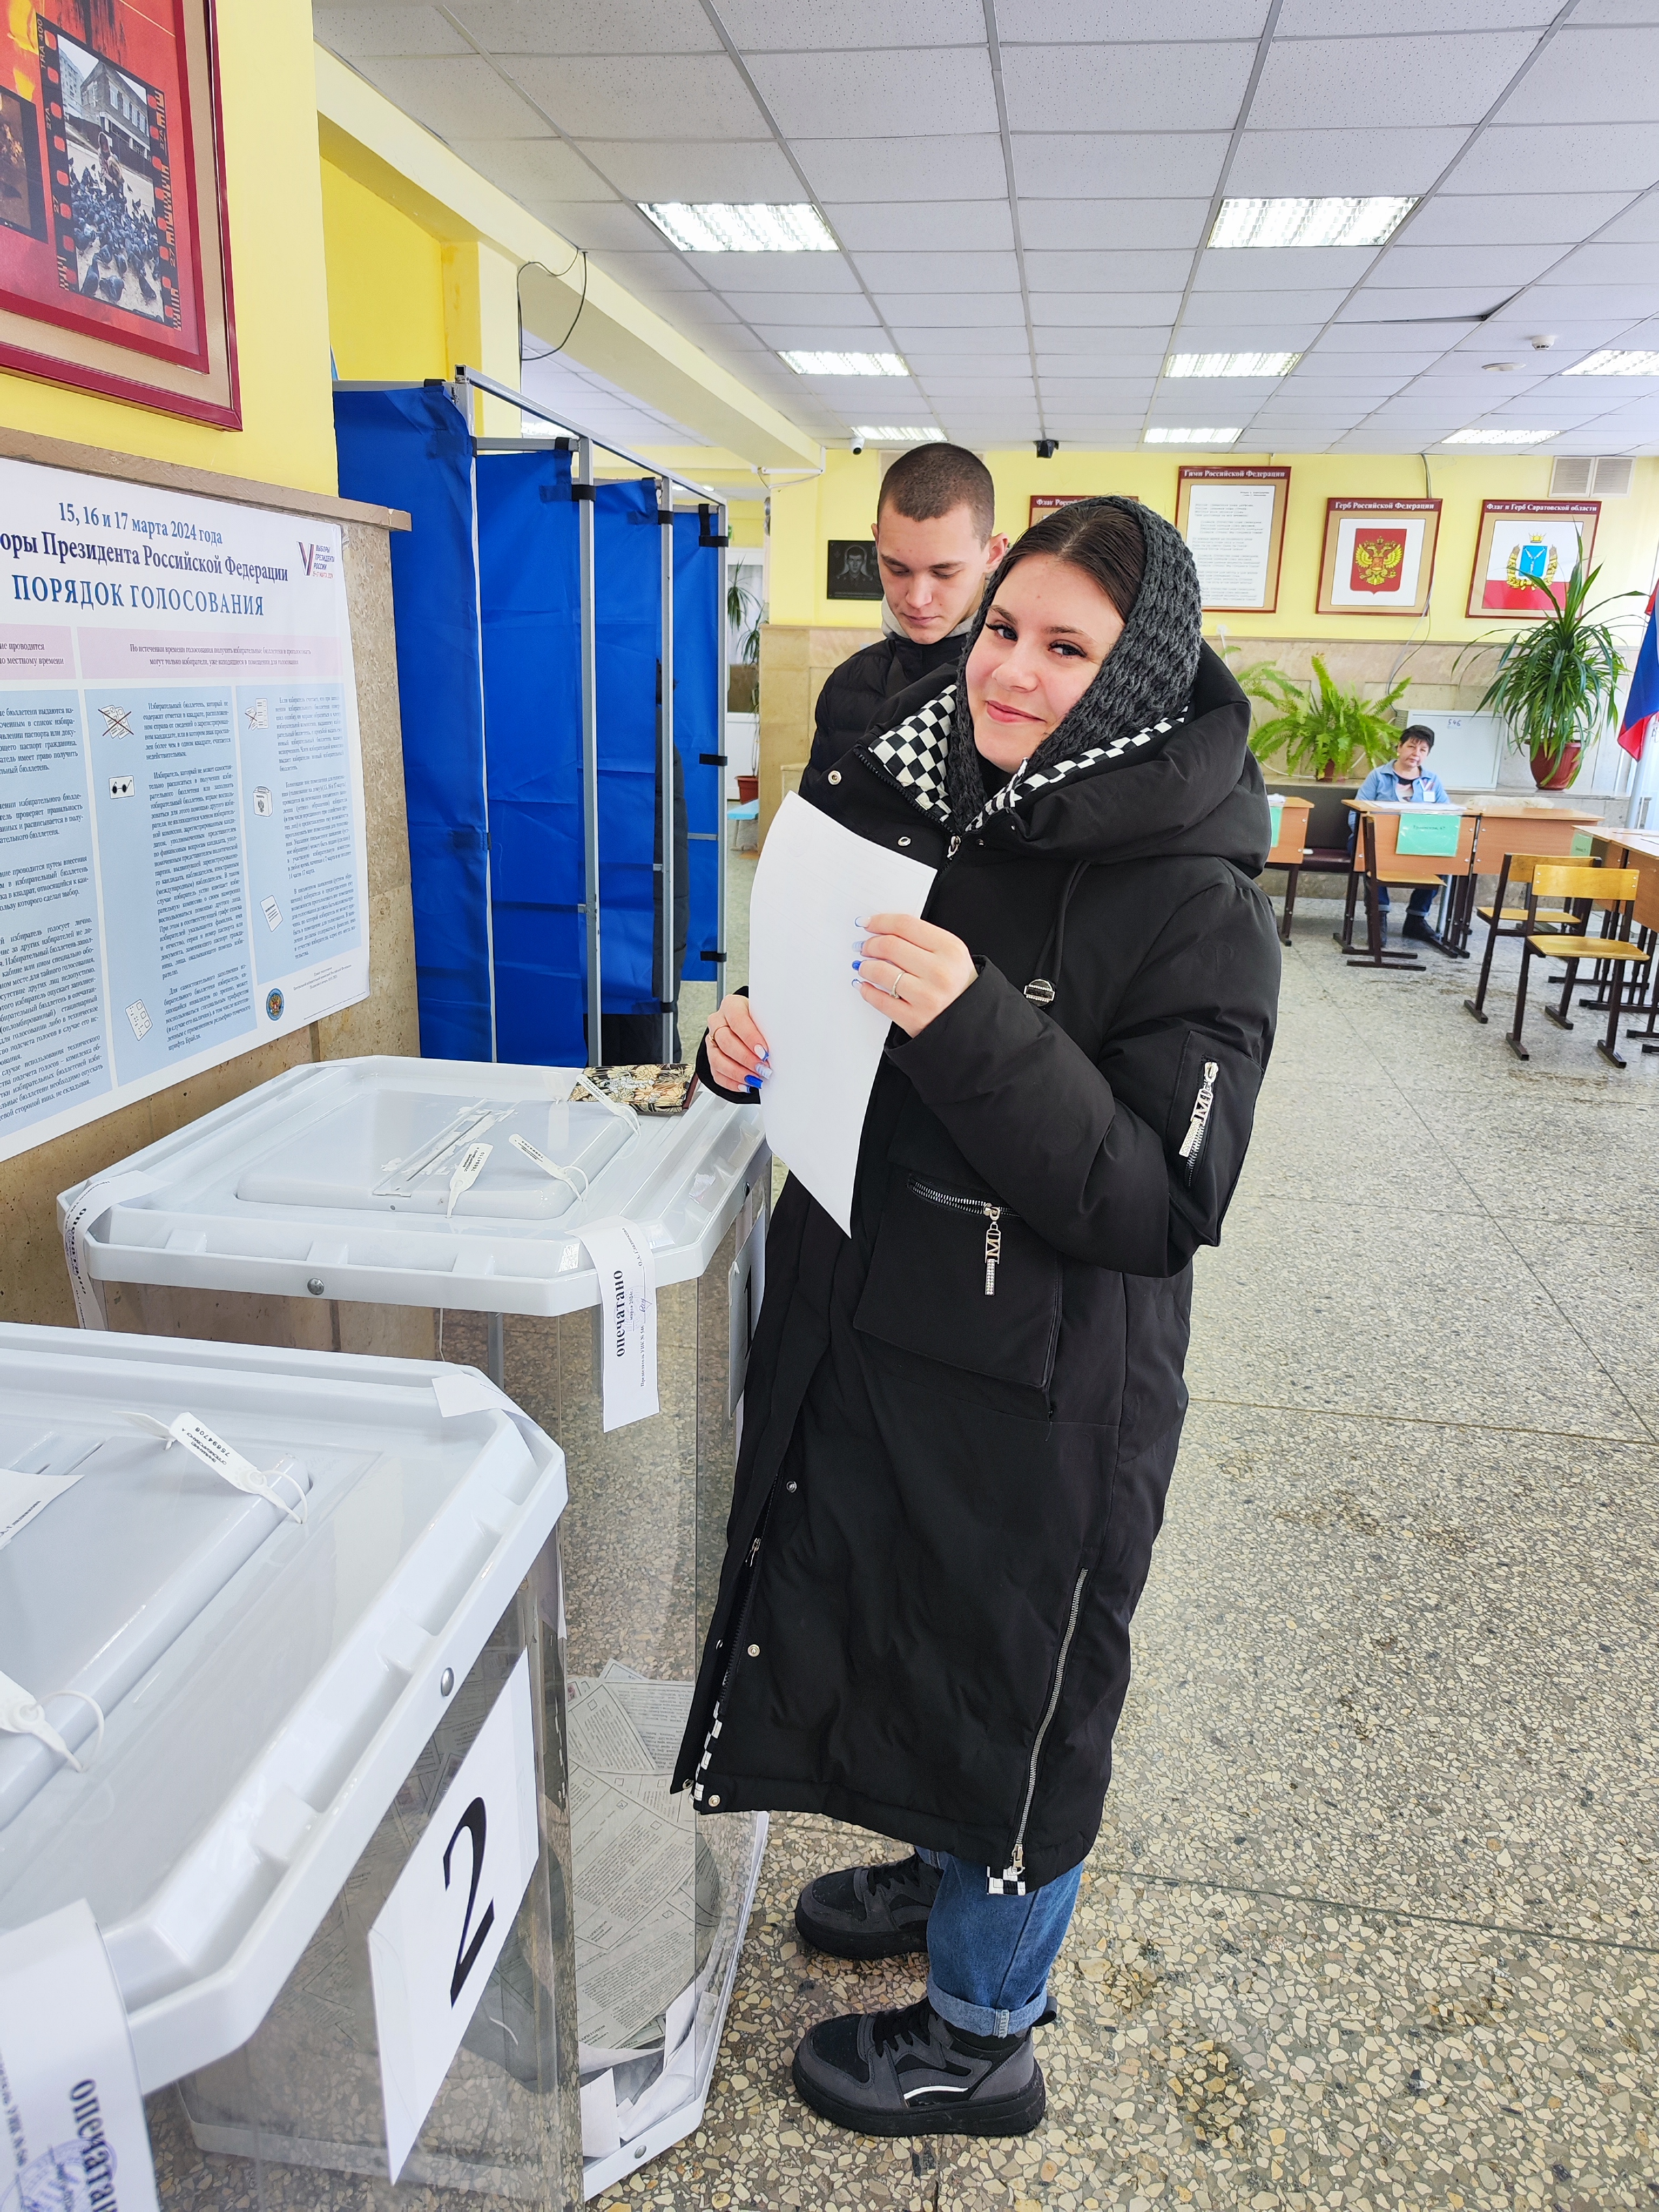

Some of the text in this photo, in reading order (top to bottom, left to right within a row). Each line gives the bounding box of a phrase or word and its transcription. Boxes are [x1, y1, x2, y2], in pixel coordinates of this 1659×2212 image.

[52, 195, 59, 214] 27
[168, 247, 176, 268] 27
[1205, 469, 1244, 477] Российской
[1246, 470, 1286, 479] Федерации
[1335, 502, 1434, 511] Герб Российской Федерации
[1510, 503, 1526, 512] Герб
[1527, 503, 1569, 512] Саратовской
[1570, 504, 1597, 512] области
[59, 502, 223, 547] 15, 16 и 17 марта 2024 года
[316, 544, 331, 554] ВЫБОРЫ
[0, 531, 288, 584] оры Президента Российской Федерации
[315, 554, 335, 562] ПРЕЗИДЕНТА
[313, 562, 327, 570] РОССИИ
[11, 574, 264, 616] ПОРЯДОК ГОЛОСОВАНИЯ
[9, 643, 45, 652] проводится
[130, 644, 138, 652] По
[165, 646, 185, 655] времени
[7, 658, 64, 667] местному времени
[150, 658, 164, 667] могут
[182, 657, 209, 667] избиратели,
[209, 659, 218, 667] уже
[6, 707, 38, 716] бюллетени
[149, 702, 182, 711] Избирательный
[55, 717, 75, 726] избира-
[24, 731, 50, 739] паспорта
[19, 740, 77, 751] паспорт гражданина.
[36, 753, 52, 761] право
[53, 751, 78, 760] получить
[18, 793, 82, 807] избирательного бюлле-
[16, 809, 44, 820] проверяет
[47, 804, 83, 815] правильность
[24, 817, 64, 831] расписывается
[69, 814, 84, 823] полу-
[29, 828, 60, 839] бюллетеня.
[12, 856, 87, 877] проводится путем внесения
[15, 866, 89, 887] избирательный бюллетень
[13, 887, 37, 898] квадрат,
[37, 879, 72, 893] относящийся
[17, 888, 80, 907] которого сделан выбор.
[10, 917, 92, 942] избиратель голосует лично.
[20, 941, 40, 952] других
[42, 930, 75, 945] избирателей
[5, 947, 49, 966] Избирательный
[49, 942, 77, 954] бюллетень
[2, 967, 23, 978] кабине
[52, 950, 82, 965] специально
[40, 967, 62, 978] тайного
[24, 1035, 100, 1068] использования технического
[12, 1048, 92, 1083] подсчета голосов комплекса
[13, 1073, 55, 1094] избирательных
[56, 1058, 87, 1076] бюллетеней
[19, 1064, 104, 1102] бюллетени необходимо опускать
[15, 1098, 41, 1114] стороной
[613, 1270, 626, 1358] опечатано
[442, 1796, 495, 2011] 2
